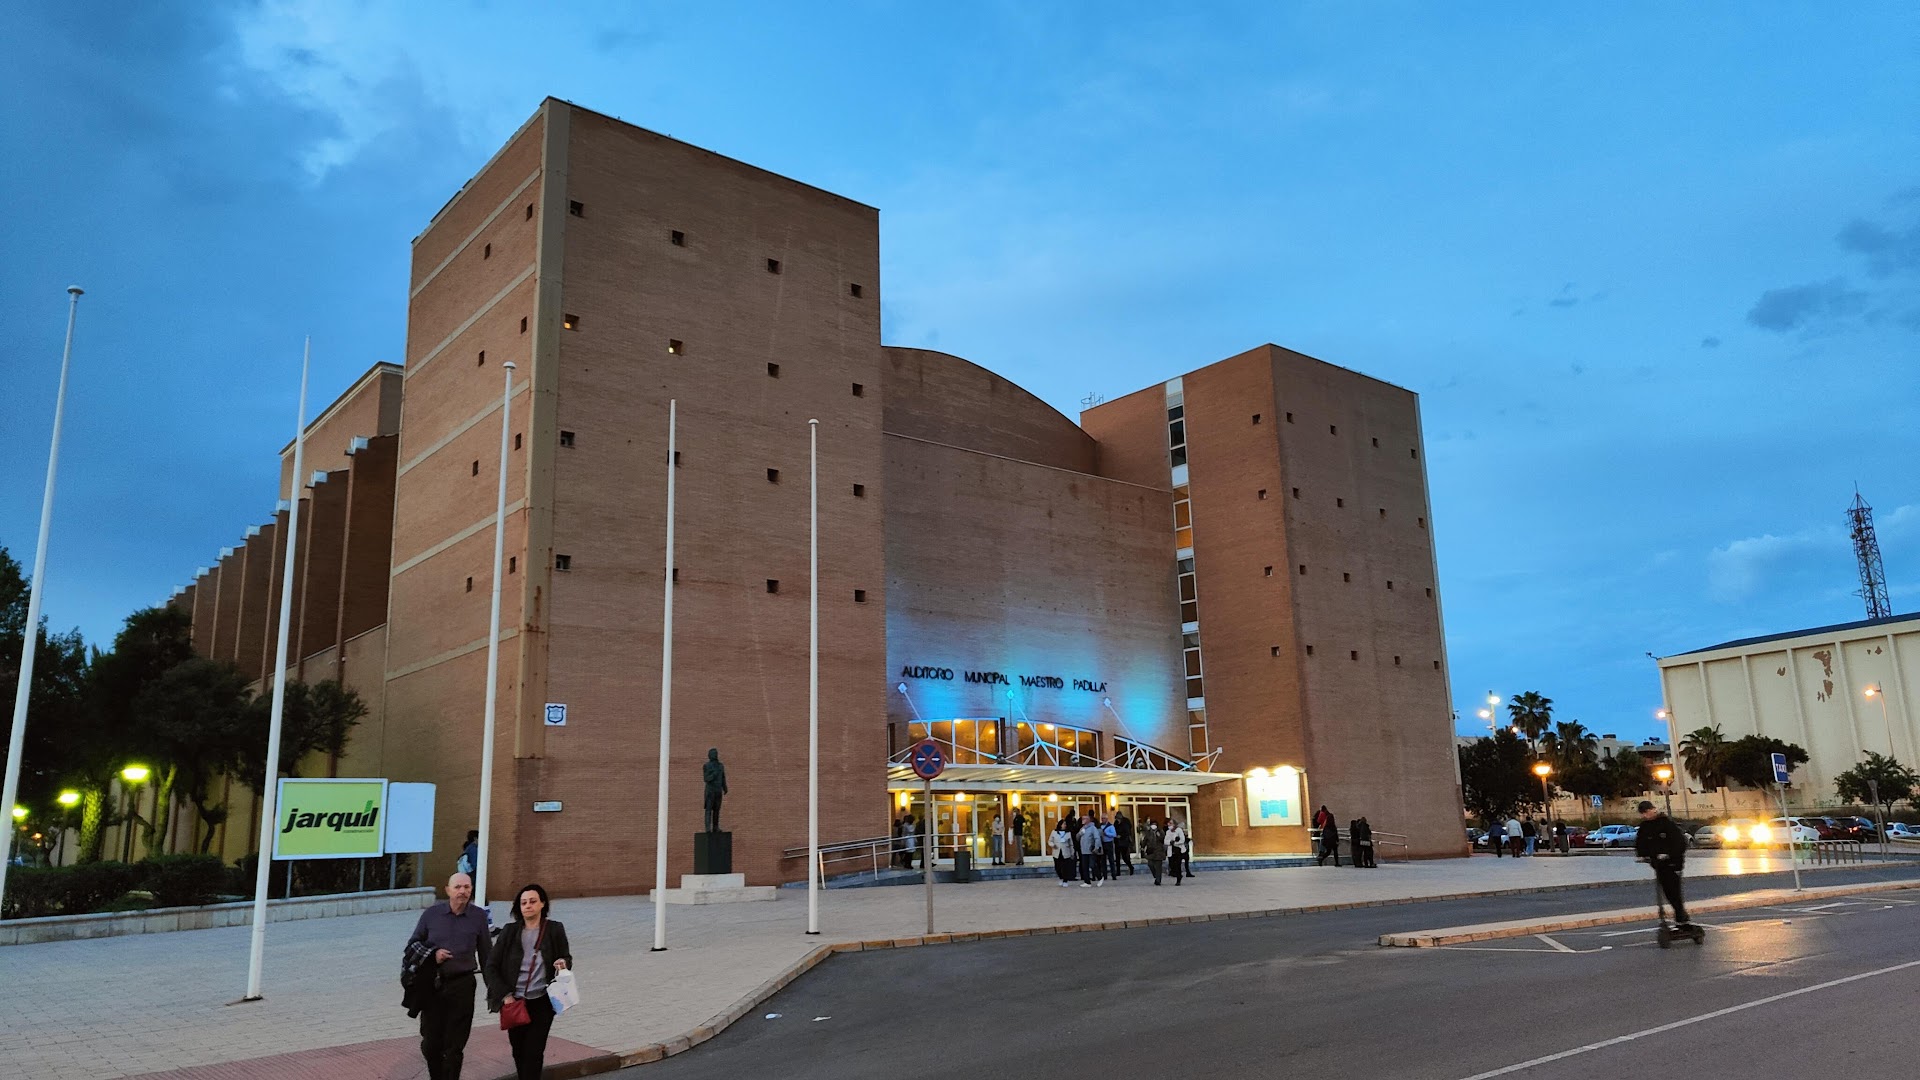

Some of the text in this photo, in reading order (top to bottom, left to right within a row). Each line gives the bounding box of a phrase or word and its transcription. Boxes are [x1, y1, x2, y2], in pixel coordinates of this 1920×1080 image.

[902, 665, 954, 681] AUDITORIO
[964, 670, 1010, 685] MUNICIPAL
[1775, 763, 1787, 773] TAXI
[281, 800, 379, 833] jarquil
